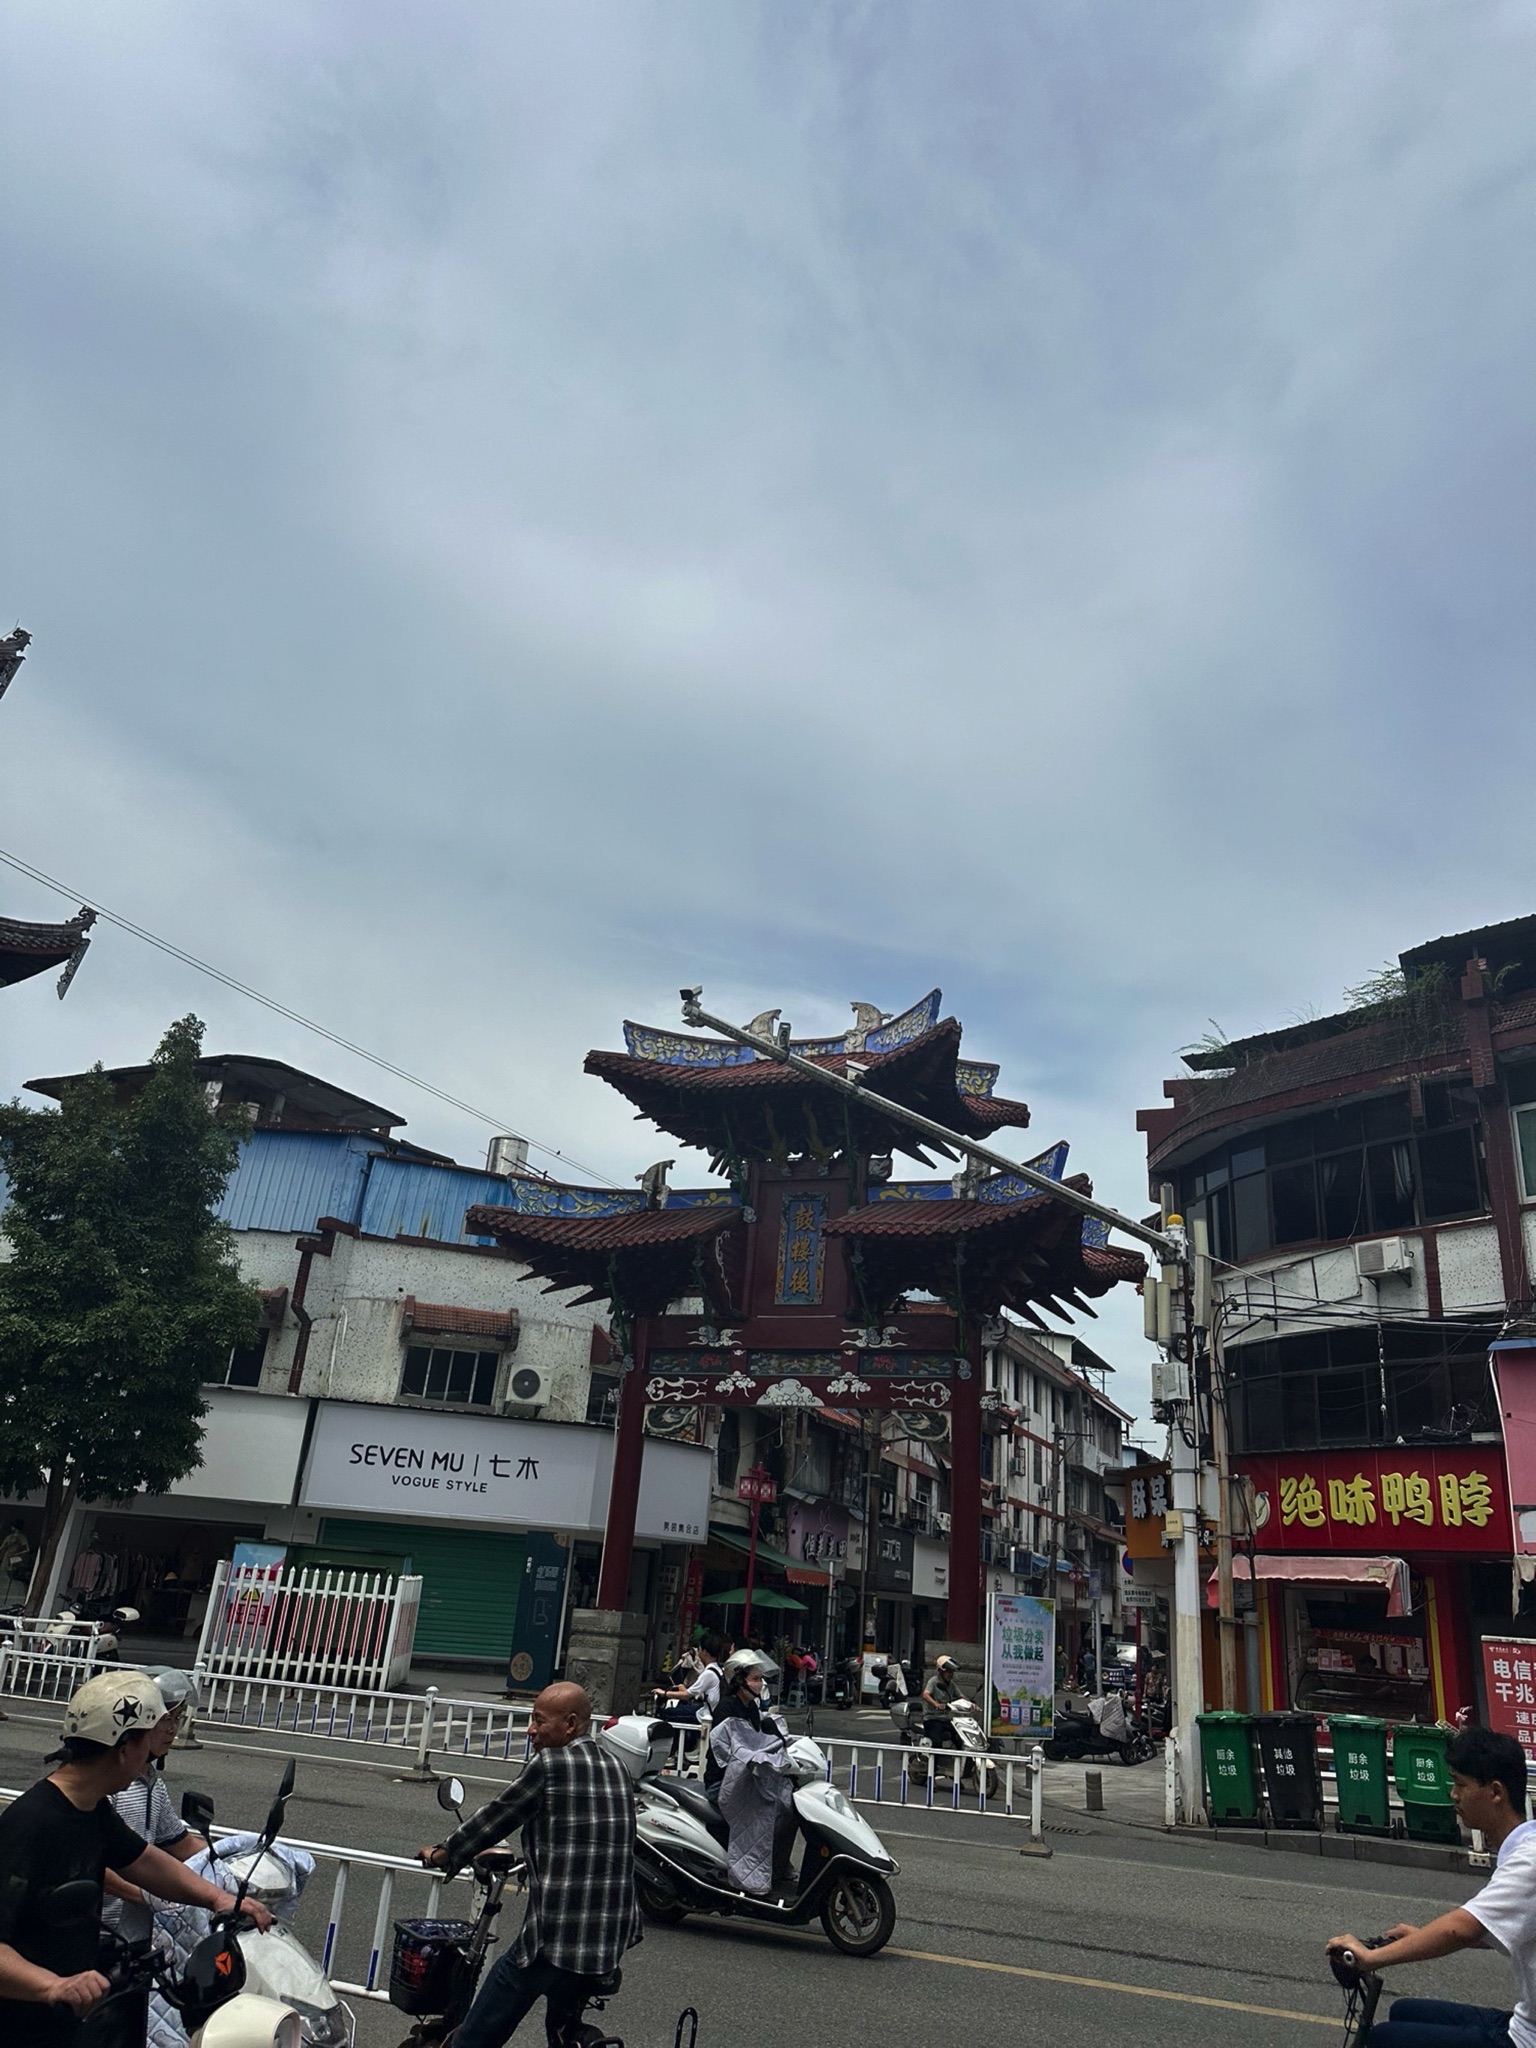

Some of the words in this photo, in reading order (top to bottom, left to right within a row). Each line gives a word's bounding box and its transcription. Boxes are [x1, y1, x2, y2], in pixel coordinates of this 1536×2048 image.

[349, 1443, 425, 1469] SEVEN
[431, 1451, 465, 1473] MU
[489, 1454, 540, 1480] 七木
[391, 1475, 441, 1489] VOGUE
[445, 1479, 488, 1493] STYLE
[1280, 1470, 1494, 1527] 绝味鸭脖
[1001, 1626, 1044, 1645] 垃圾分类
[1001, 1643, 1044, 1661] 从我做起
[1493, 1658, 1536, 1681] 电信
[1518, 1729, 1536, 1744] 品
[1216, 1748, 1236, 1761] 厨余
[1273, 1748, 1293, 1760] 其他
[1348, 1752, 1369, 1765] 厨余
[1218, 1764, 1238, 1776] 垃圾
[1276, 1763, 1296, 1776] 垃圾
[1416, 1758, 1435, 1769] 厨余
[1349, 1768, 1370, 1781] 垃圾
[1417, 1771, 1436, 1782] 垃圾
